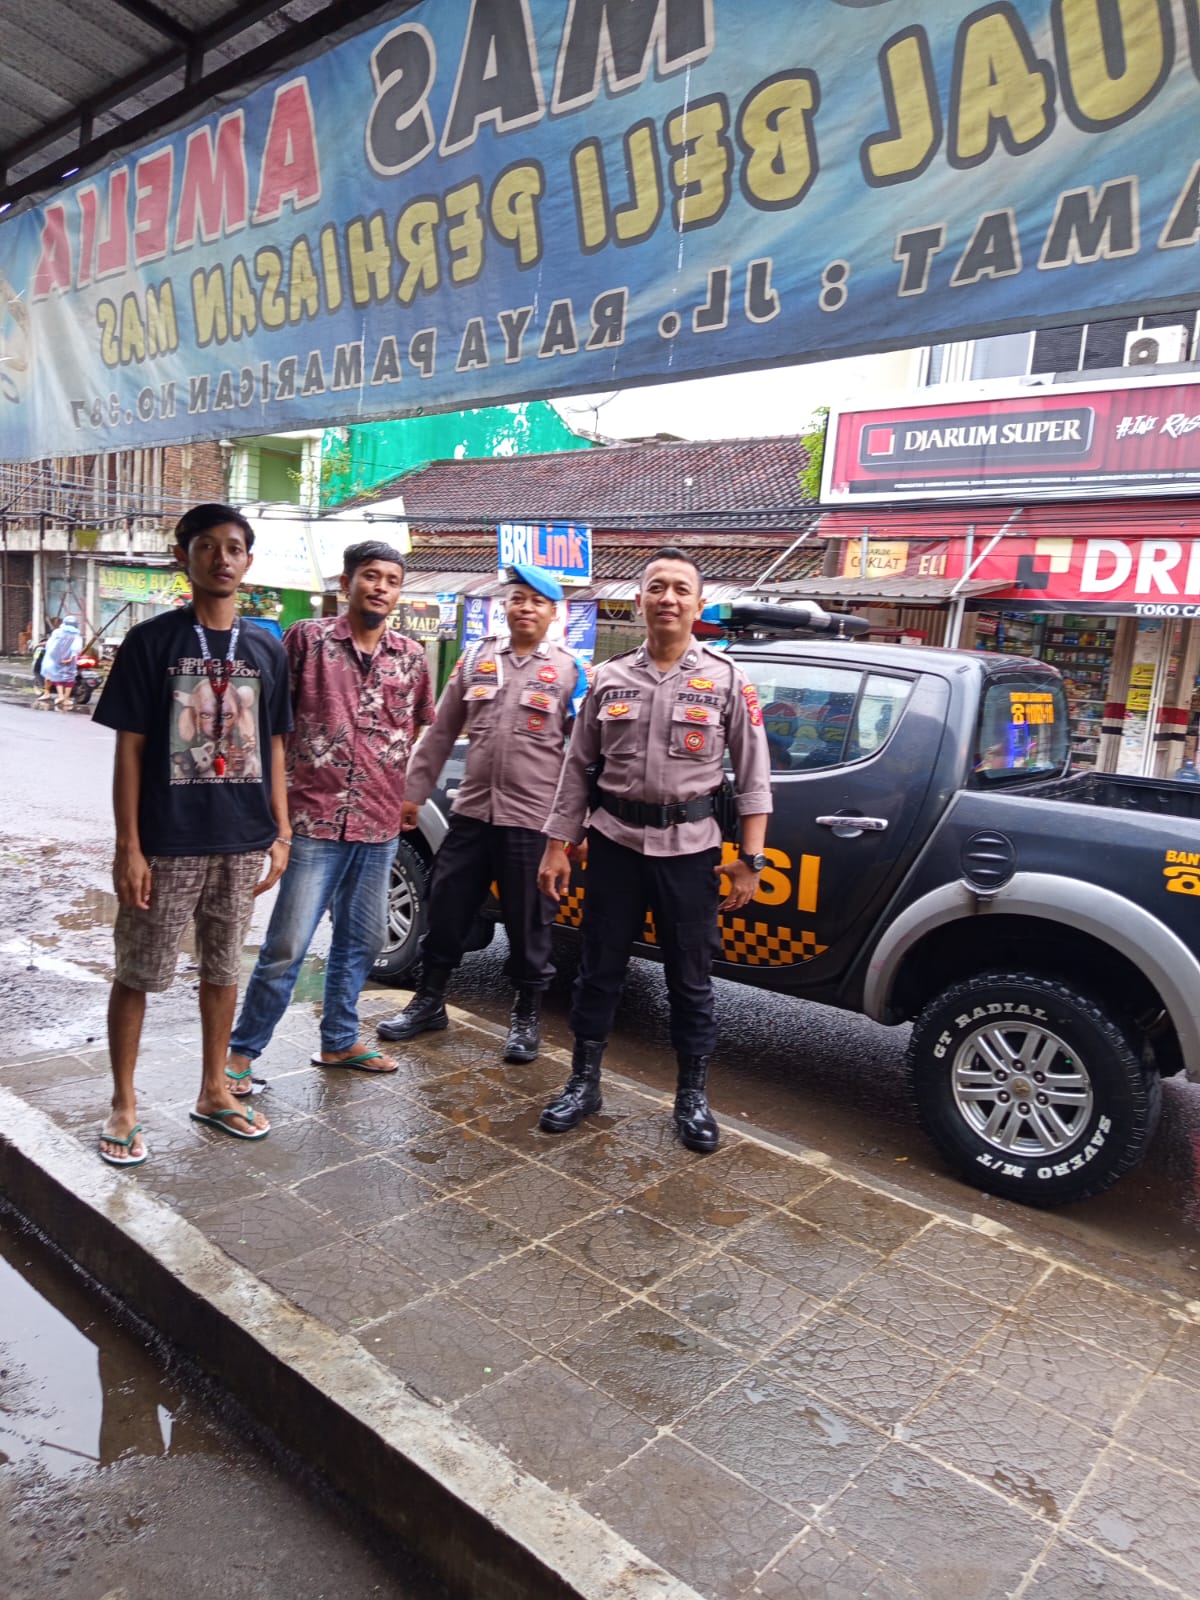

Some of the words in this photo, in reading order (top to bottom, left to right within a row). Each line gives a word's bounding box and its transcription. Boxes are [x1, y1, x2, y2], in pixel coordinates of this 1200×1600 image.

[904, 425, 998, 451] DJARUM
[1000, 419, 1082, 444] SUPER
[501, 524, 584, 568] BRILink
[850, 556, 901, 570] CKLAT
[918, 554, 948, 575] ELI
[1134, 604, 1179, 616] TOKO
[167, 666, 195, 675] THE
[178, 657, 222, 667] BRIG
[604, 690, 641, 700] ARIEF
[677, 692, 721, 706] POLRI
[933, 1030, 953, 1058] GT
[955, 1003, 1049, 1029] RADIAL
[1036, 1115, 1112, 1179] SAVERO
[976, 1152, 1027, 1179] M/T
